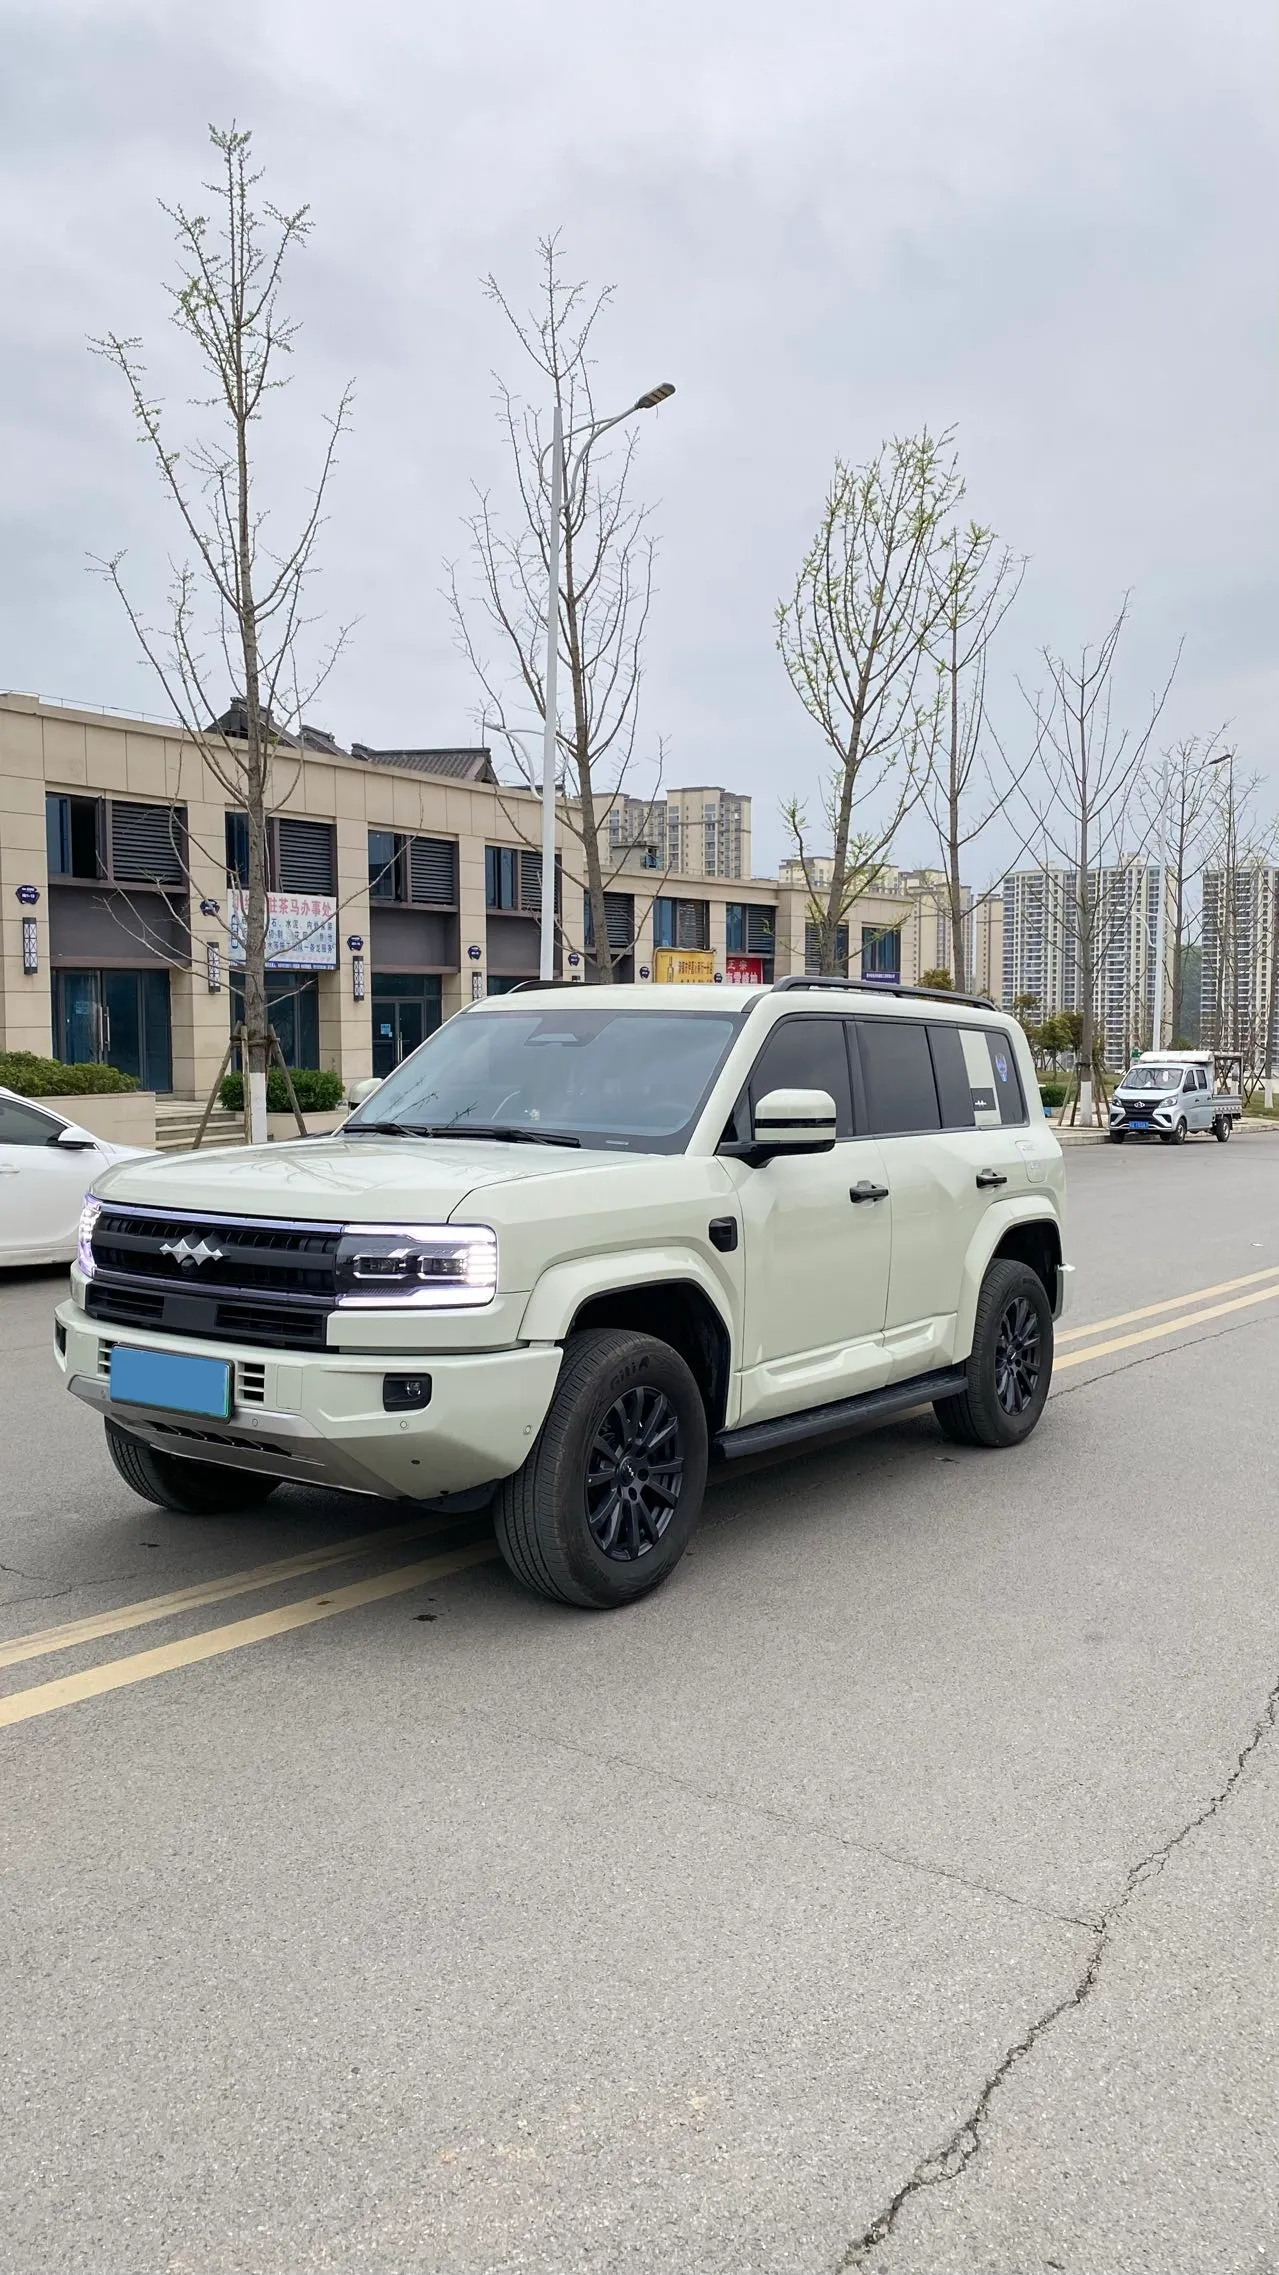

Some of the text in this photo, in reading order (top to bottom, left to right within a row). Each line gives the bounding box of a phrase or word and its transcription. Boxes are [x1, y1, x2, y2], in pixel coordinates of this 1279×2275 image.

[234, 894, 332, 918] 驻茶马办事处
